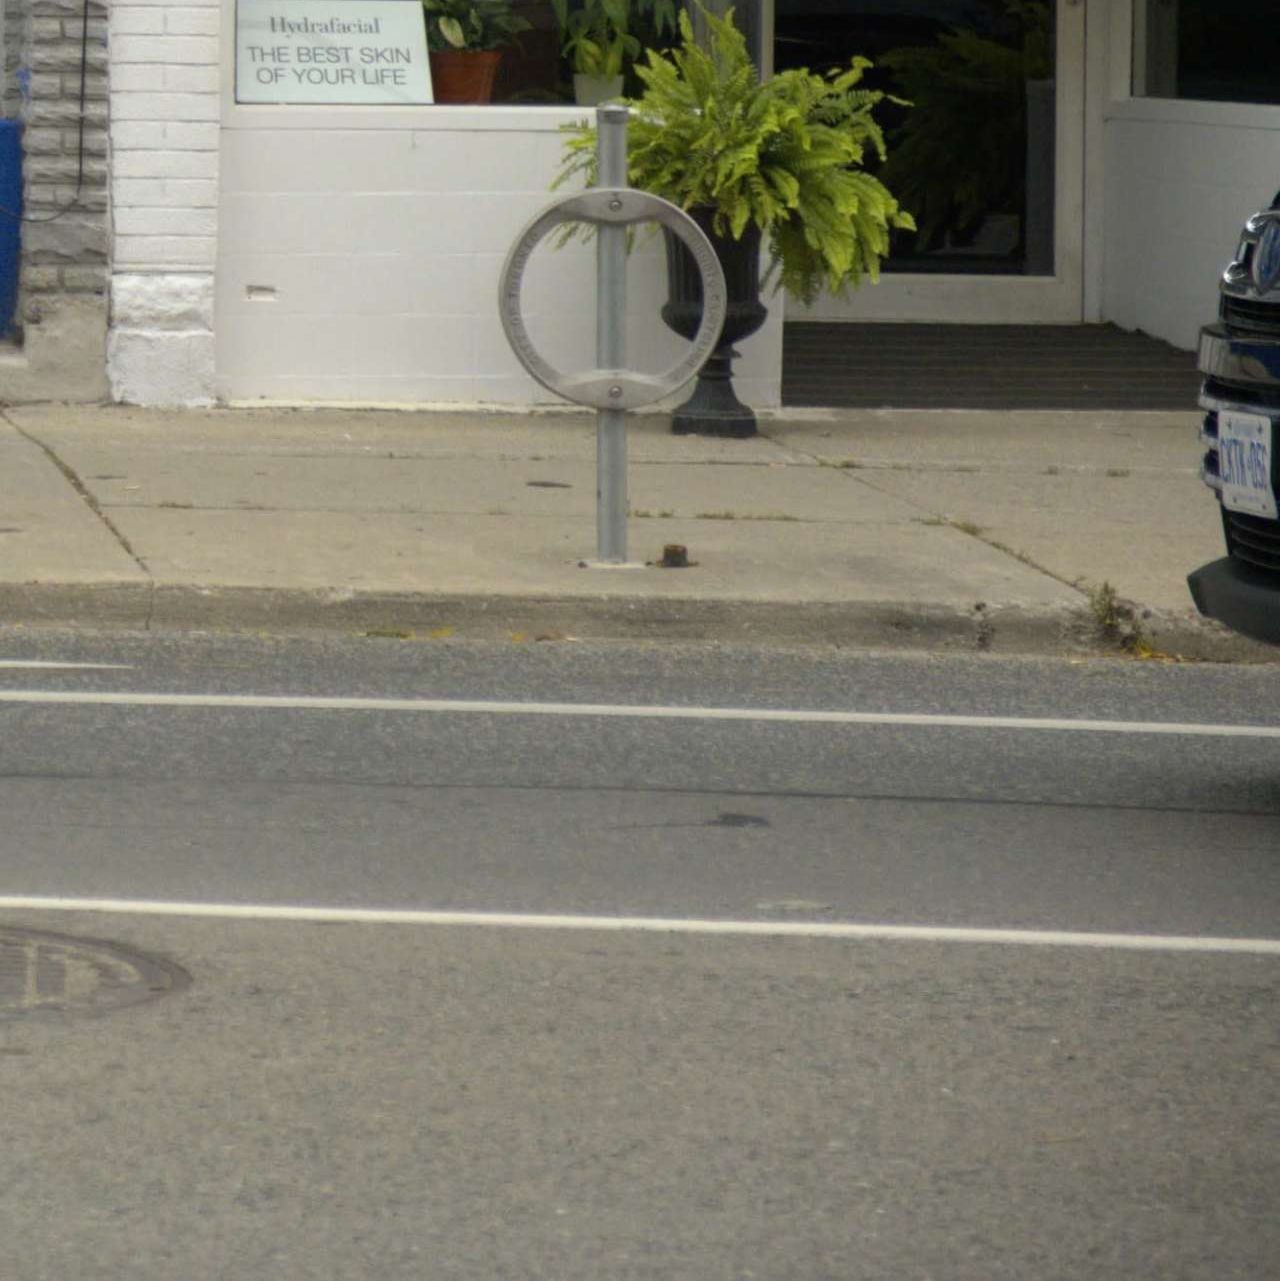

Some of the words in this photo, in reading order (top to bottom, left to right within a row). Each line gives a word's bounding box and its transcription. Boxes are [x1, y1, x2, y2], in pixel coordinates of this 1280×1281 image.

[269, 16, 381, 39] Hydrafacial
[246, 45, 290, 63] THE
[296, 46, 353, 64] BEST
[359, 47, 412, 65] SKIN
[256, 67, 289, 85] OF
[291, 68, 357, 86] YOUR
[361, 68, 408, 86] LIFE
